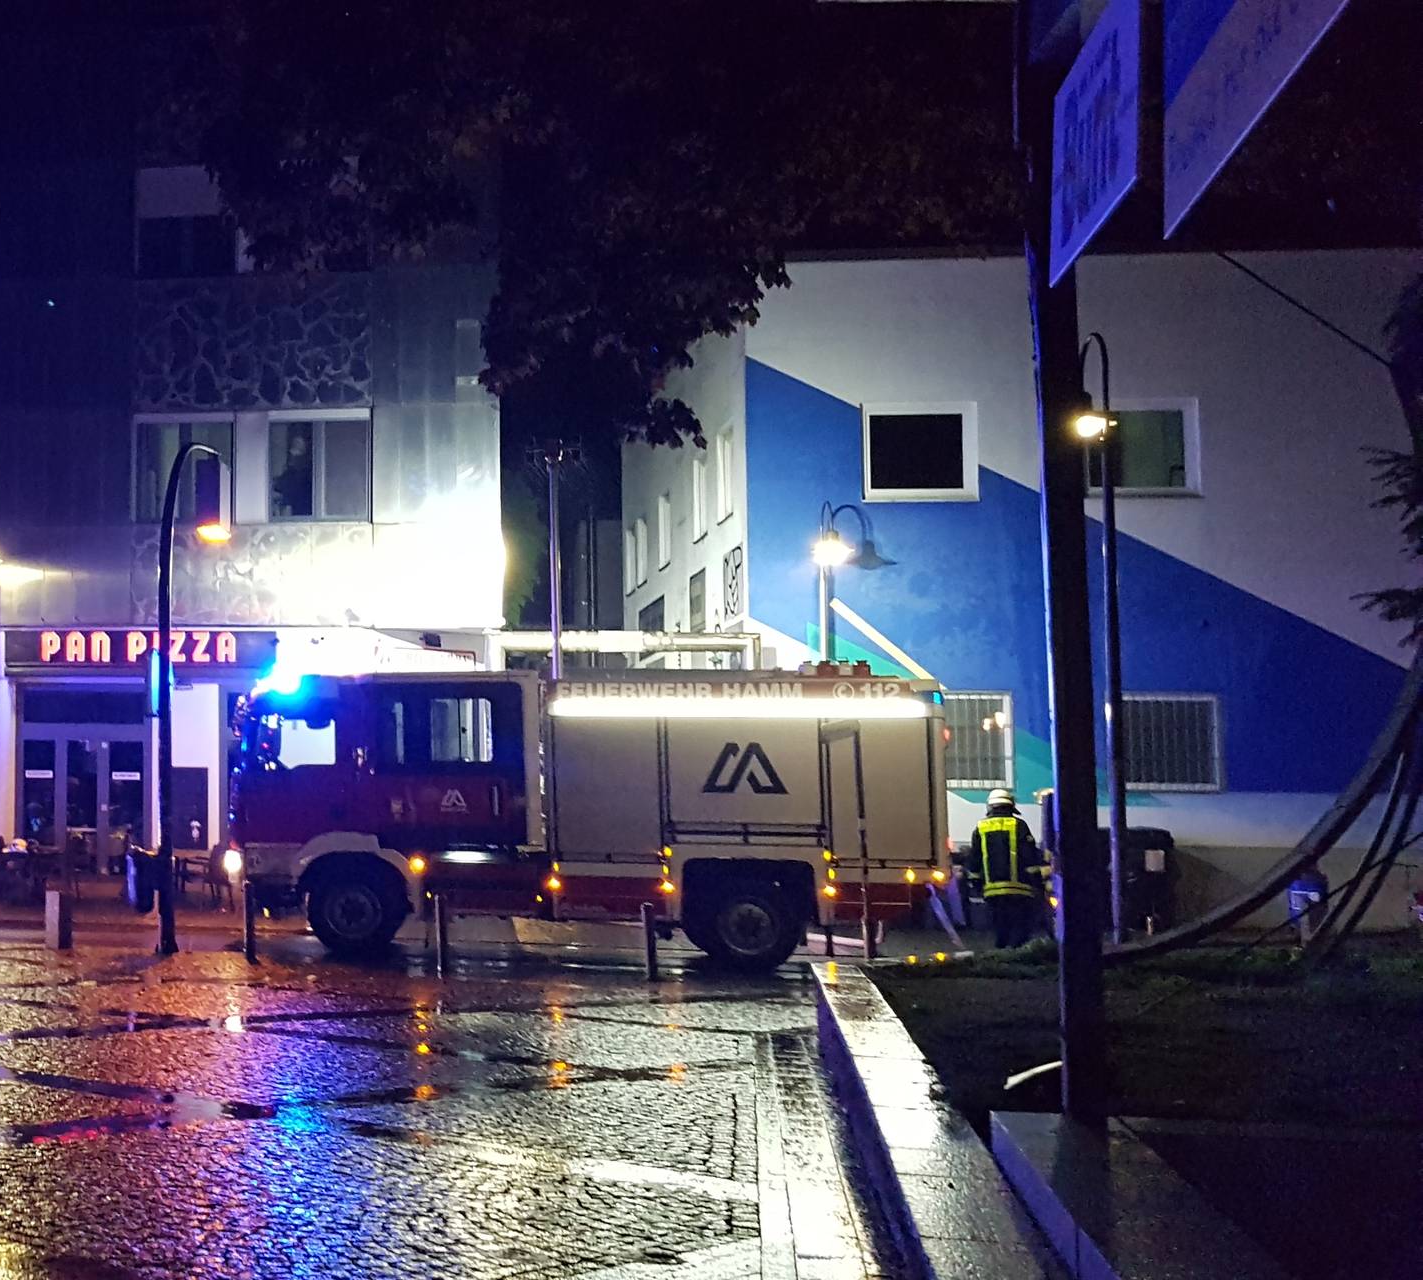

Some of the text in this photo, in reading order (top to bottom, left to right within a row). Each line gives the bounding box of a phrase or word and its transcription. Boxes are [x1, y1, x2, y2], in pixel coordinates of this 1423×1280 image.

[40, 630, 111, 663] PAN
[127, 630, 237, 663] PIZZA
[558, 682, 901, 699] FEUERWEHR HAMM 112
